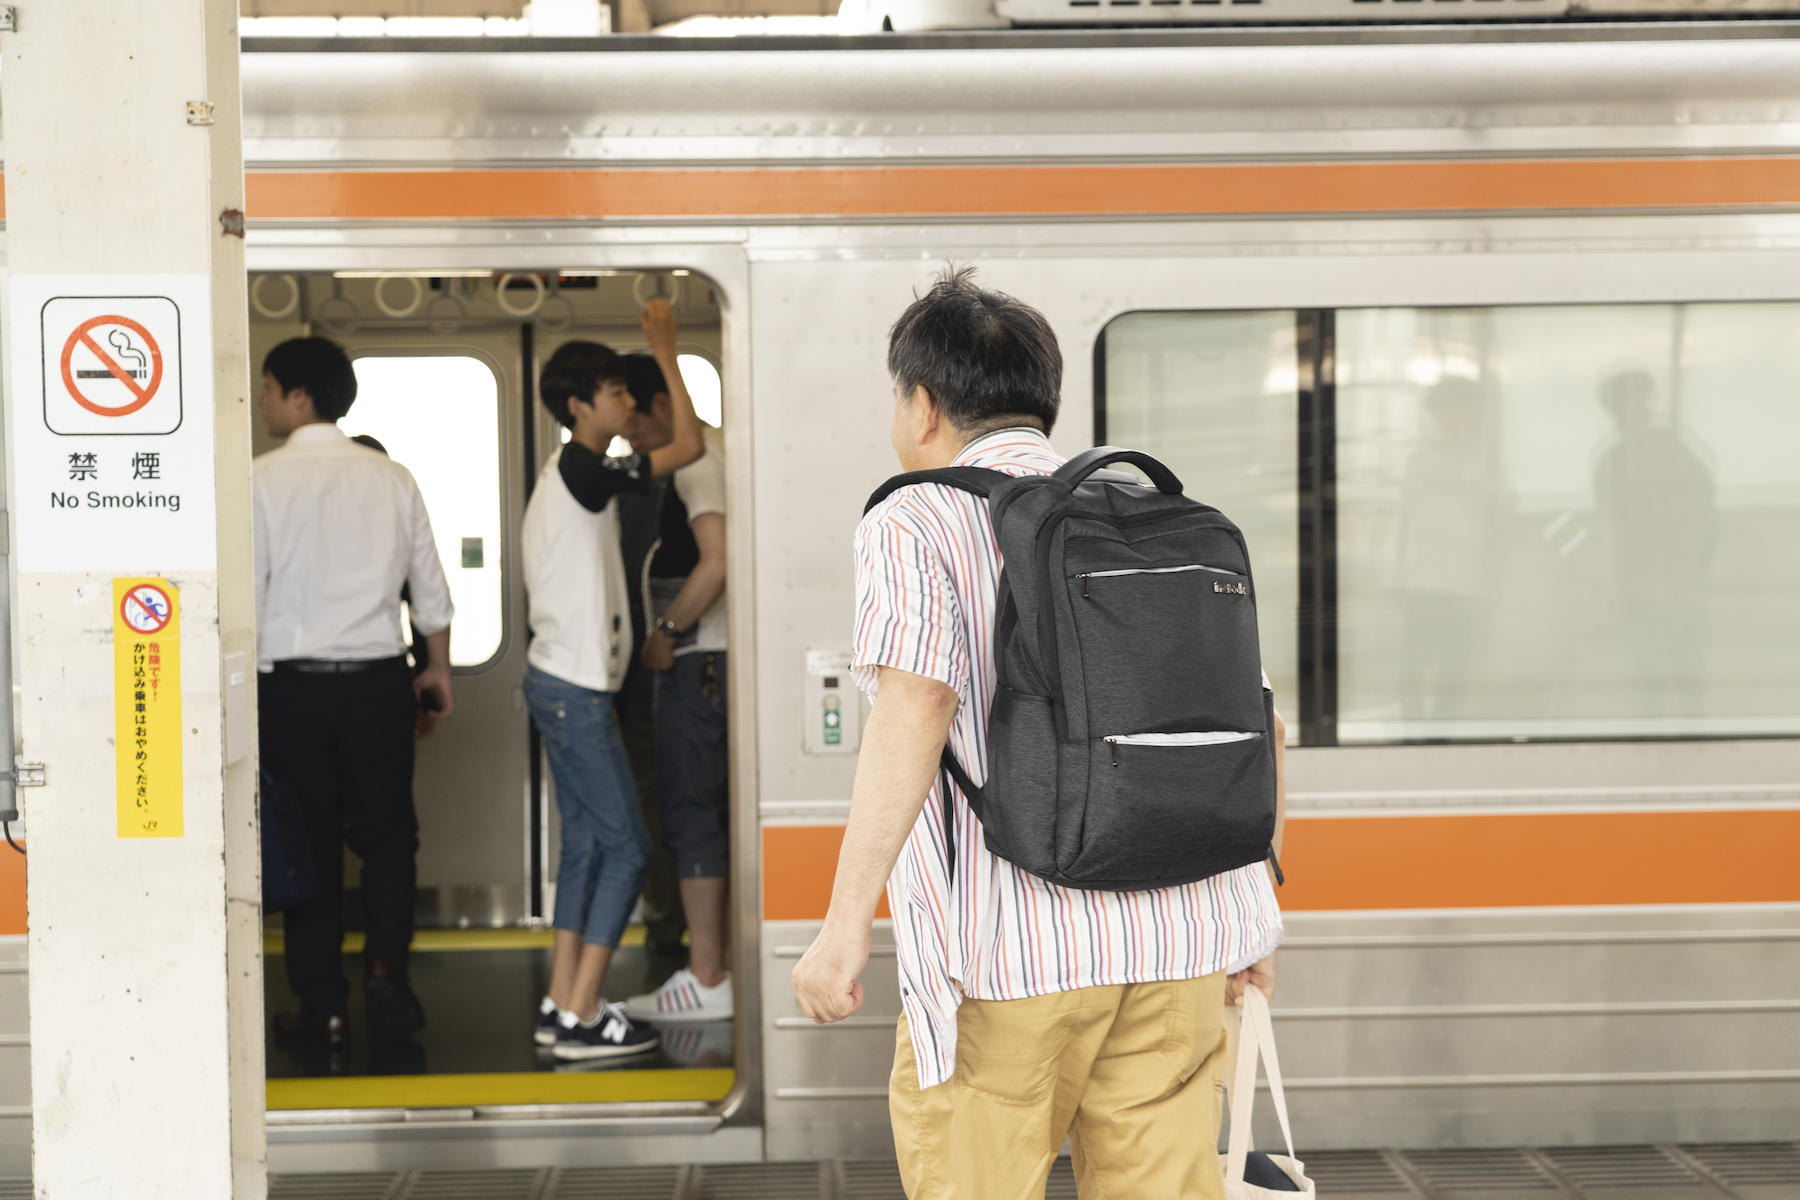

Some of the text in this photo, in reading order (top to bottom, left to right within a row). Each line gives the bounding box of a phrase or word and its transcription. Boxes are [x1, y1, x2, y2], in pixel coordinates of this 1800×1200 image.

[69, 453, 160, 480] 禁煙
[51, 491, 180, 512] No Smoking
